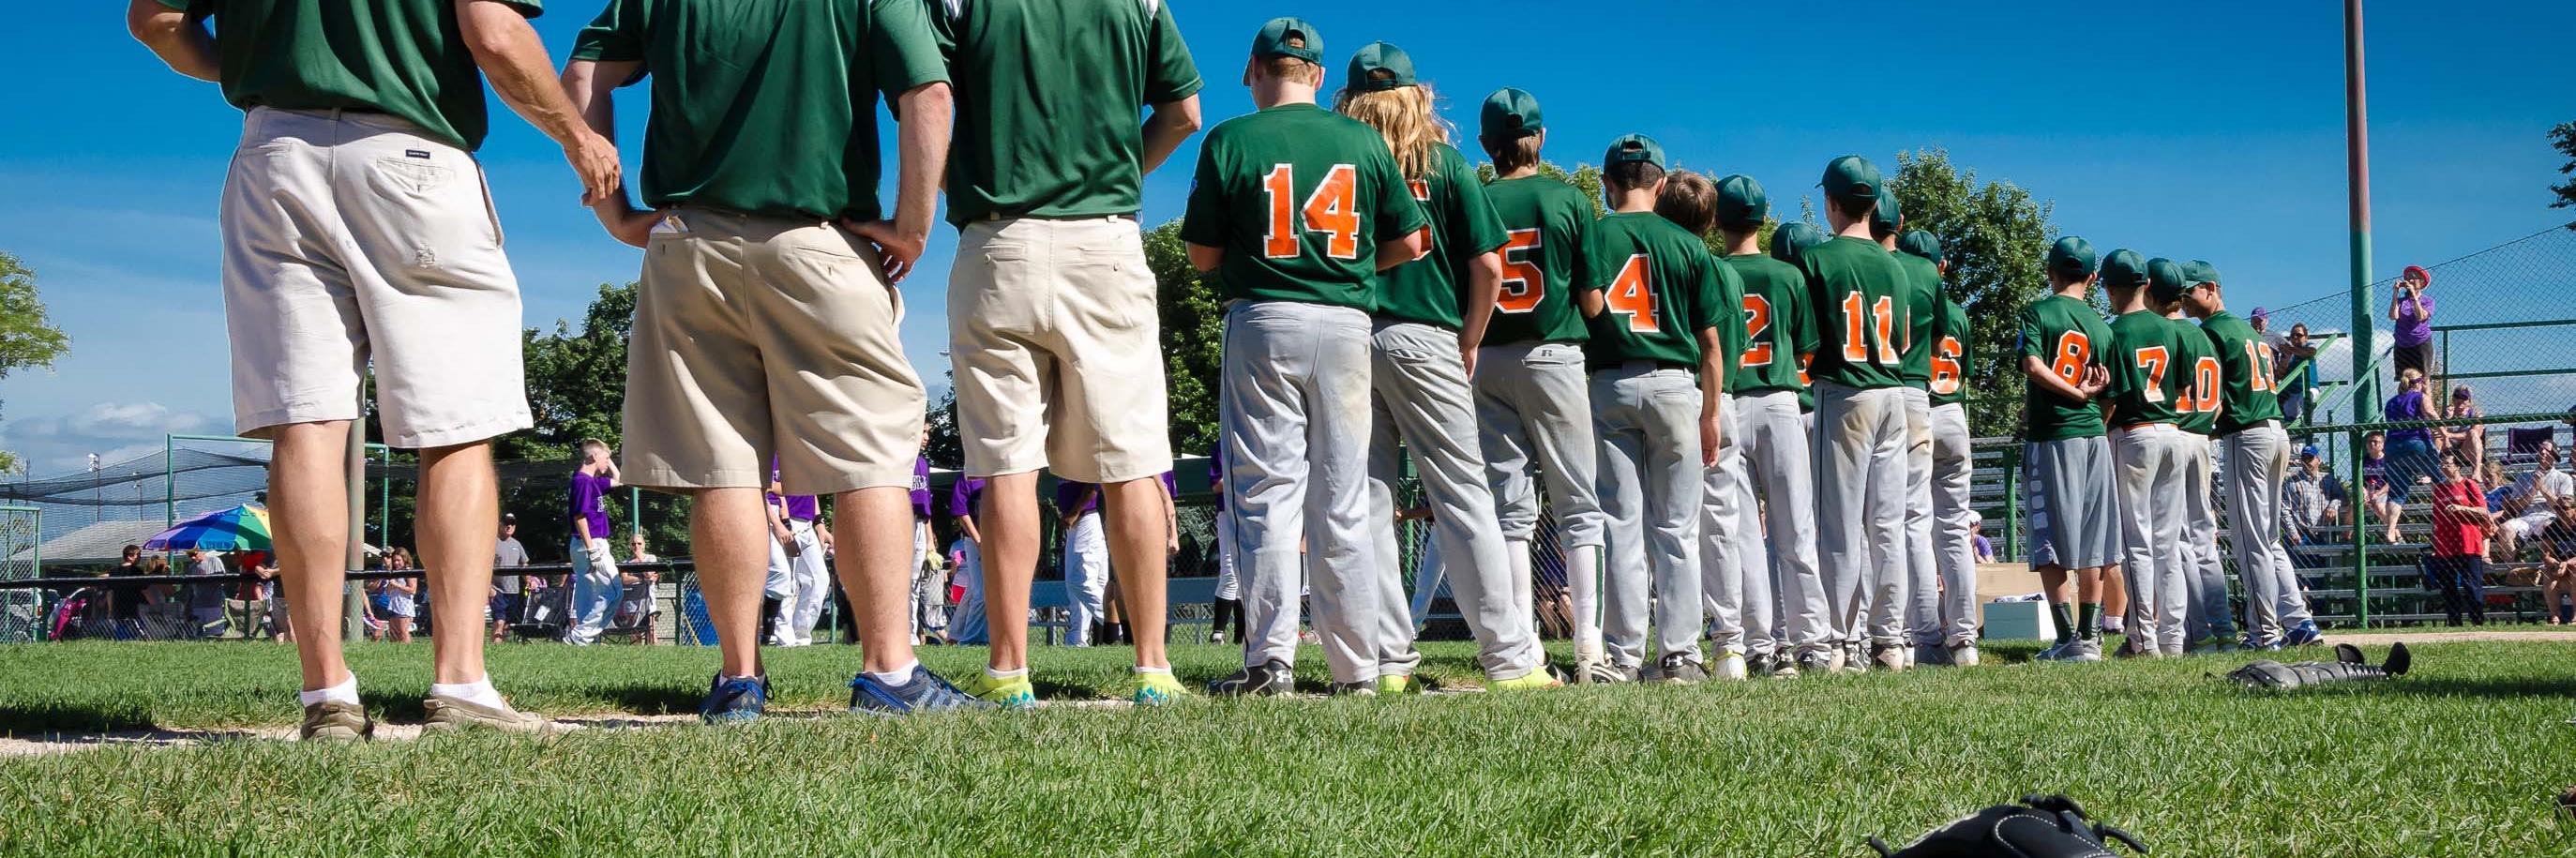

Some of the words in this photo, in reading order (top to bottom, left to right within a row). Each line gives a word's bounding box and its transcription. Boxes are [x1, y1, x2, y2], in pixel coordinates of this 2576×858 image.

[1263, 163, 1360, 259] 14
[1495, 228, 1544, 313] 5
[1604, 253, 1660, 333] 4
[1742, 293, 1772, 366] 2
[1843, 291, 1900, 364] 11
[2052, 329, 2091, 386] 8
[1930, 335, 1962, 394] 6
[2136, 345, 2169, 403] 7
